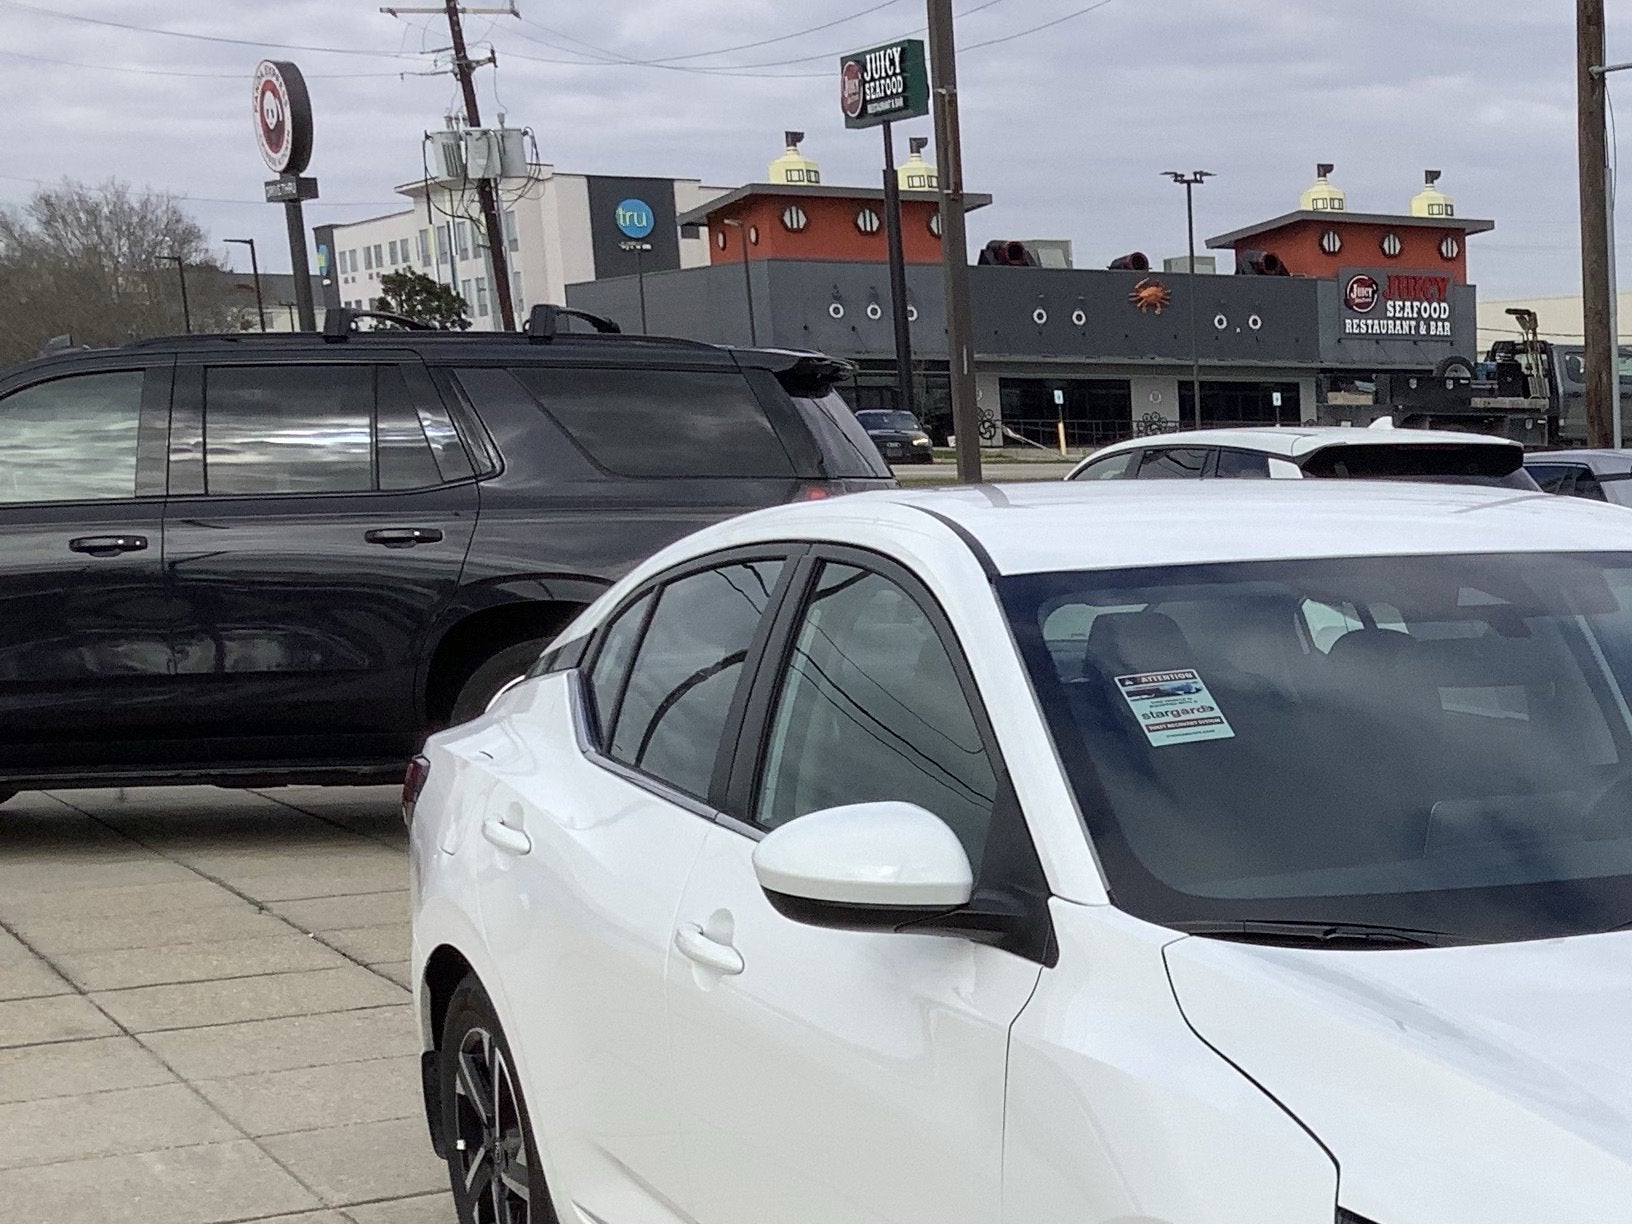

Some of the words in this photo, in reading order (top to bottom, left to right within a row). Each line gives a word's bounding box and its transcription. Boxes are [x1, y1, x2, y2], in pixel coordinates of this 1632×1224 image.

[863, 47, 901, 80] JUICY
[865, 75, 903, 100] SEAFOOD
[616, 207, 648, 228] tru
[1350, 283, 1373, 299] JUICY
[1383, 274, 1450, 302] JUICY
[1386, 300, 1450, 319] SEAFOOD
[1345, 319, 1417, 335] RESTAURANT
[1419, 322, 1427, 335] &
[1429, 321, 1452, 336] BAR
[1141, 672, 1193, 683] ATTENTION
